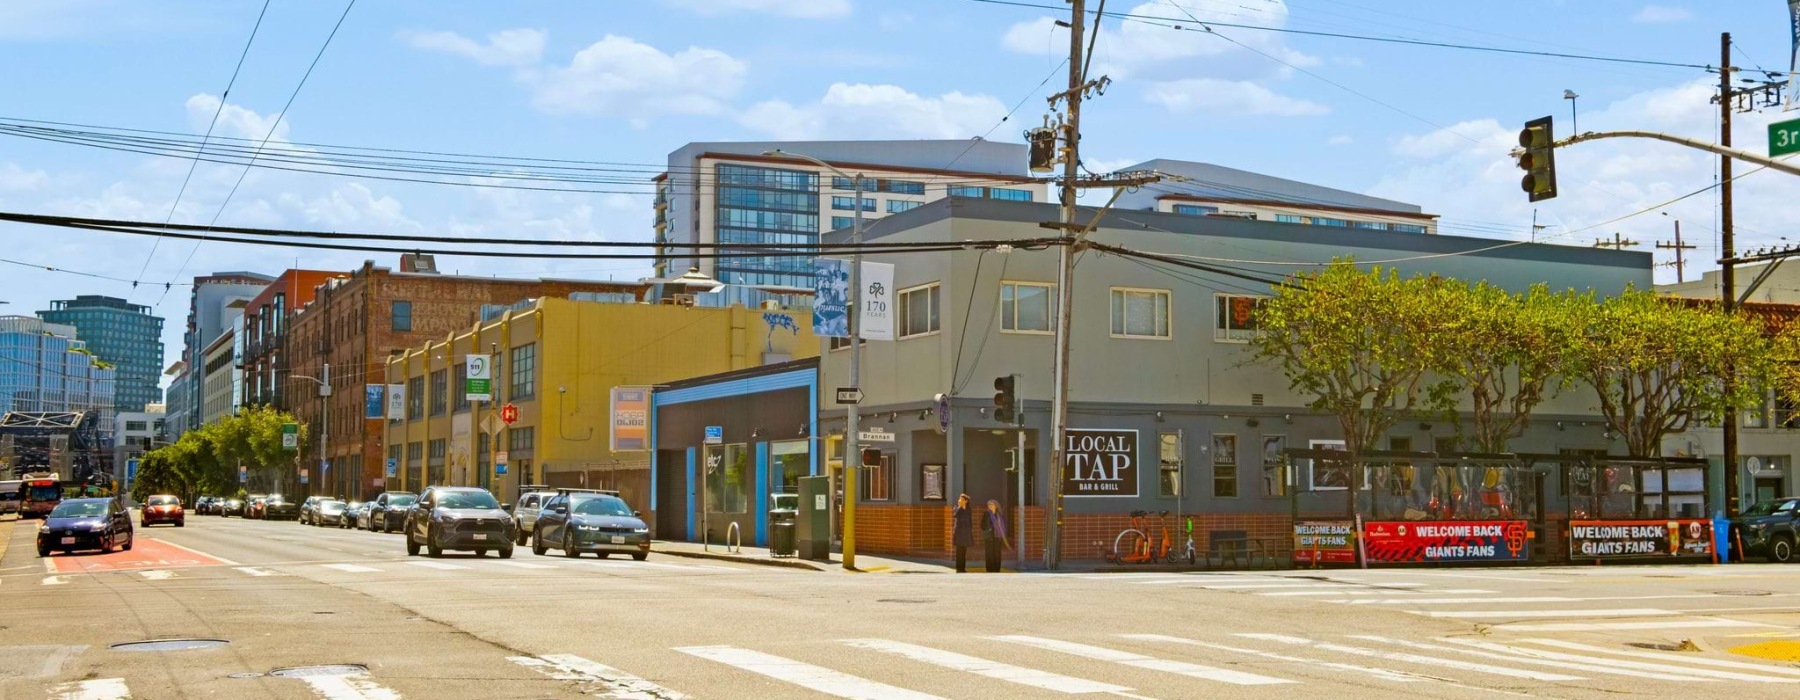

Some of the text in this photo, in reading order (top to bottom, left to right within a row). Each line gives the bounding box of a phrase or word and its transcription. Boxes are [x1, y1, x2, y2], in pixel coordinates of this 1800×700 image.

[866, 300, 886, 312] 170
[505, 409, 515, 419] H
[1066, 435, 1131, 452] LOCAL
[1066, 453, 1131, 481] TAP
[1079, 483, 1119, 491] BAR & GRILL
[1295, 525, 1351, 535] WELCOME BACK
[1416, 526, 1472, 537] WELCOME
[1473, 525, 1502, 537] BACK
[1573, 526, 1663, 539] WELCOME BACK
[1327, 536, 1346, 545] FANS
[1425, 545, 1495, 558] GIANTS FANS
[1581, 541, 1655, 554] GIANTS FANS
